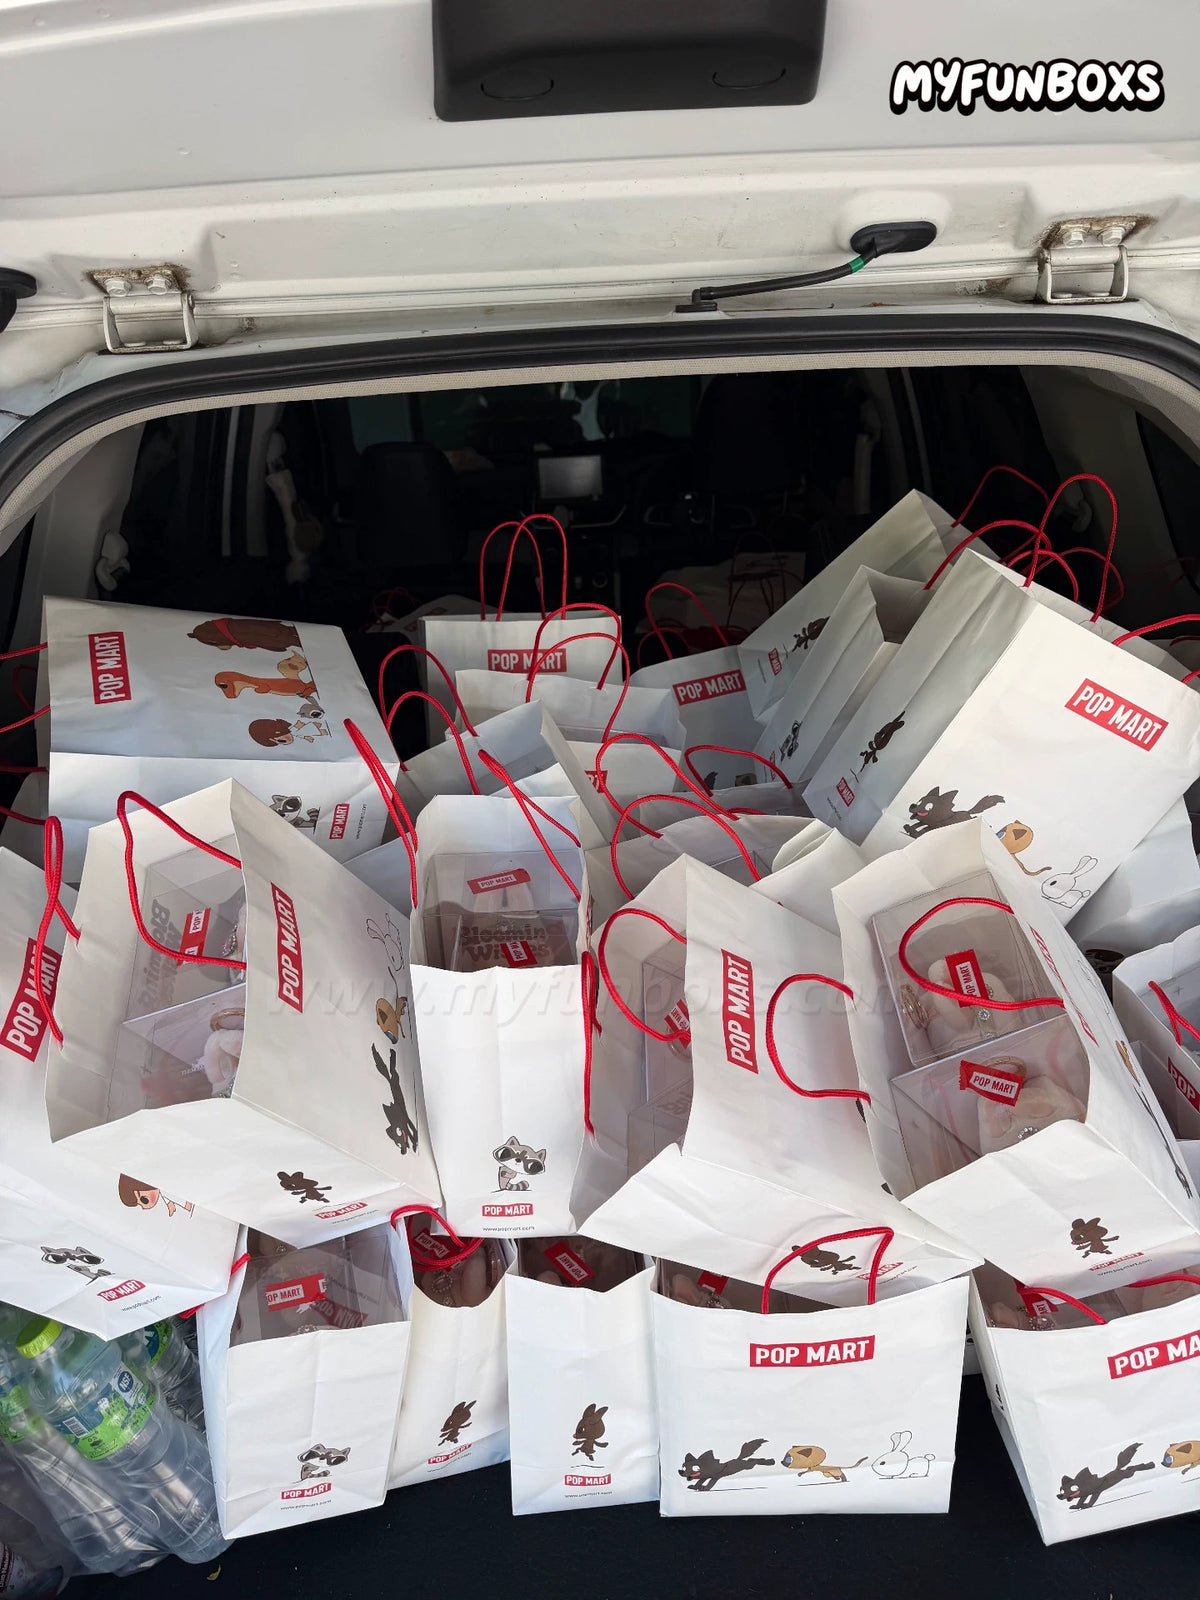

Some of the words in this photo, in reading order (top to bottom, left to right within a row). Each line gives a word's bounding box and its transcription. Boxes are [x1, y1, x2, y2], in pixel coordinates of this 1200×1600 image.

[93, 636, 122, 670] MART
[491, 652, 519, 670] POP
[98, 673, 126, 700] POP
[676, 684, 703, 702] POP
[704, 673, 742, 696] MART
[1072, 685, 1115, 718] POP
[1108, 704, 1162, 745] MART
[335, 806, 348, 825] MART
[332, 825, 343, 838] POP
[480, 880, 494, 888] POP
[275, 889, 298, 955] MART
[281, 954, 300, 1005] POP
[959, 965, 973, 984] MART
[727, 956, 751, 1019] MART
[965, 985, 977, 996] OP
[5, 1001, 42, 1054] POP
[728, 1019, 754, 1066] POP
[973, 1075, 990, 1087] POP
[991, 1080, 1015, 1094] MART
[1169, 1064, 1196, 1099] POP
[338, 1202, 366, 1214] MART
[484, 1206, 503, 1216] POP
[504, 1204, 531, 1216] MART
[100, 1291, 118, 1301] POP
[116, 1280, 141, 1296] MART
[266, 1294, 279, 1302] OP
[280, 1287, 301, 1300] MART
[756, 1346, 800, 1365] POP
[806, 1339, 870, 1364] MART
[1114, 1346, 1160, 1376] POP
[119, 1373, 131, 1391] NSF
[566, 1476, 583, 1485] POP
[585, 1476, 609, 1485] MART
[283, 1490, 302, 1499] POP
[304, 1484, 328, 1497] MART
